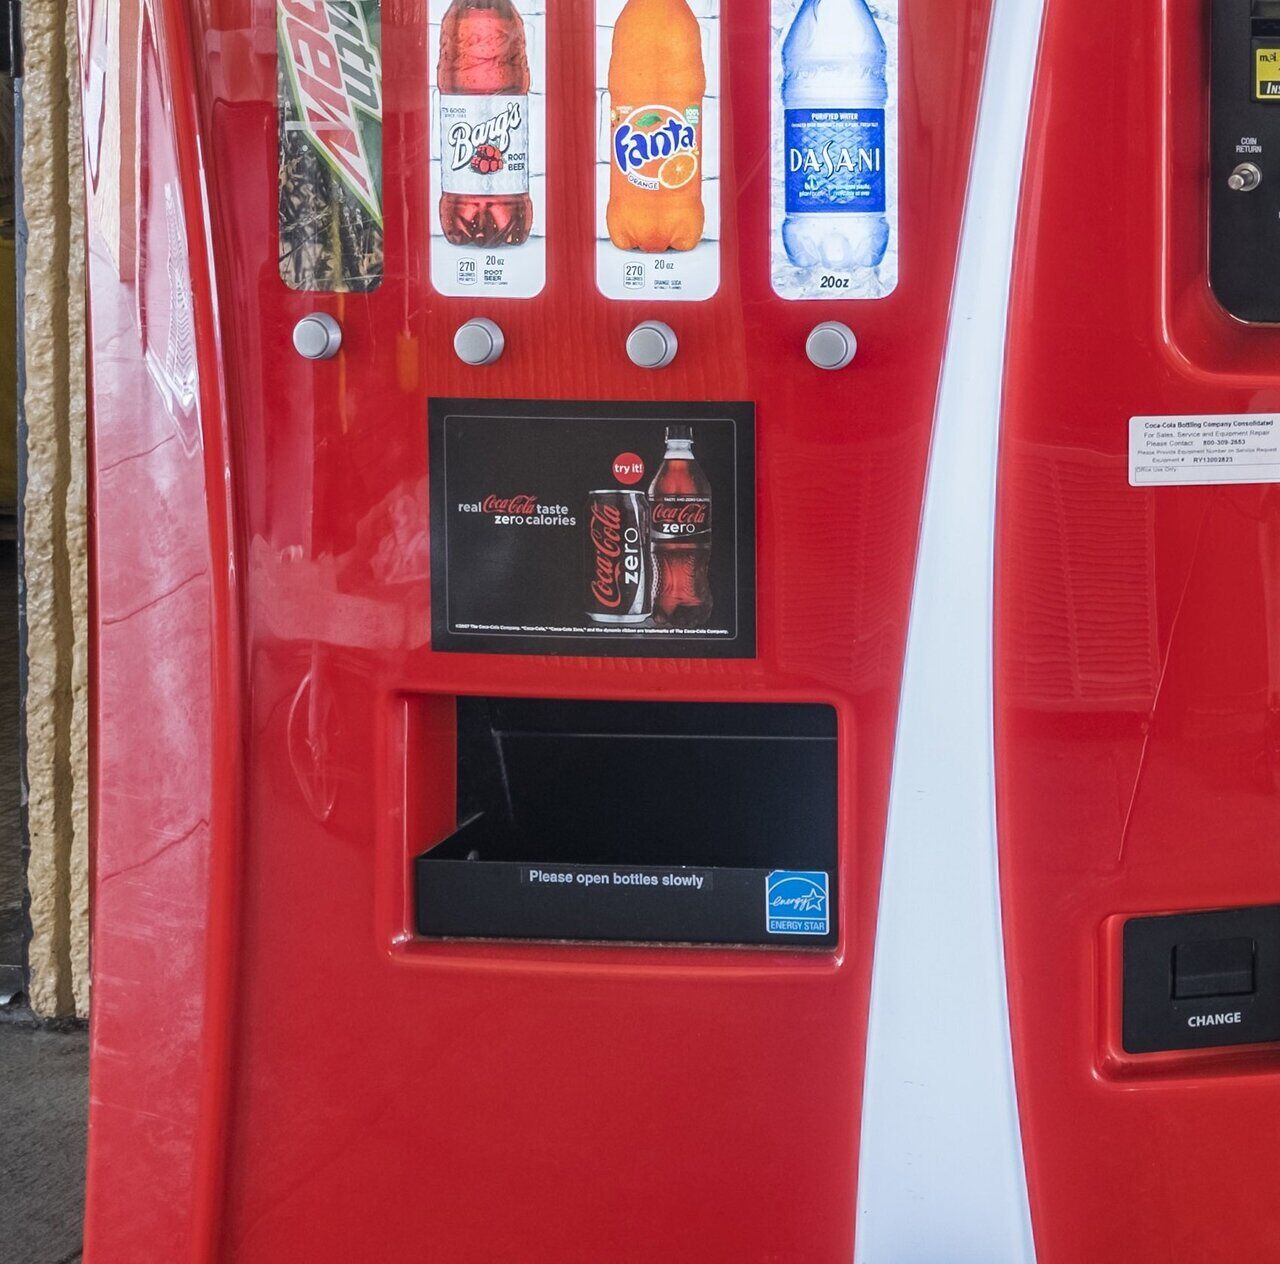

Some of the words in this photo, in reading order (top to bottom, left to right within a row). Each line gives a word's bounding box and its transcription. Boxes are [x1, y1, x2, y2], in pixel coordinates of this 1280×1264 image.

[448, 102, 522, 171] Barq's
[1241, 137, 1257, 145] COIN
[615, 119, 694, 172] Fanta
[1236, 145, 1261, 153] RETURN
[508, 153, 525, 161] ROOT
[790, 140, 880, 180] DASANI
[508, 163, 525, 171] BEER
[628, 175, 659, 189] ORANGE
[486, 255, 496, 265] 20
[654, 260, 665, 269] 20
[460, 262, 475, 271] 270
[626, 266, 643, 275] 270
[1178, 421, 1201, 429] Bottling
[1215, 430, 1248, 438] Equipment
[1249, 430, 1270, 438] Repair
[614, 464, 630, 474] try
[632, 463, 643, 473] it!
[458, 502, 482, 512] real
[482, 494, 538, 514] Coca-Cola
[536, 503, 569, 514] taste
[653, 503, 706, 523] Coca-Cola
[494, 516, 524, 525] zero
[525, 514, 576, 526] calories
[663, 524, 695, 533] zero
[591, 500, 621, 608] Coca-Cola
[624, 527, 638, 584] zero
[529, 870, 573, 883] Please
[576, 874, 610, 886] open
[613, 873, 658, 886] bottles
[662, 874, 704, 889] slowly
[770, 896, 808, 911] energy
[771, 921, 802, 930] ENERGY
[804, 921, 825, 931] STAR
[1187, 1012, 1241, 1027] CHANGE
